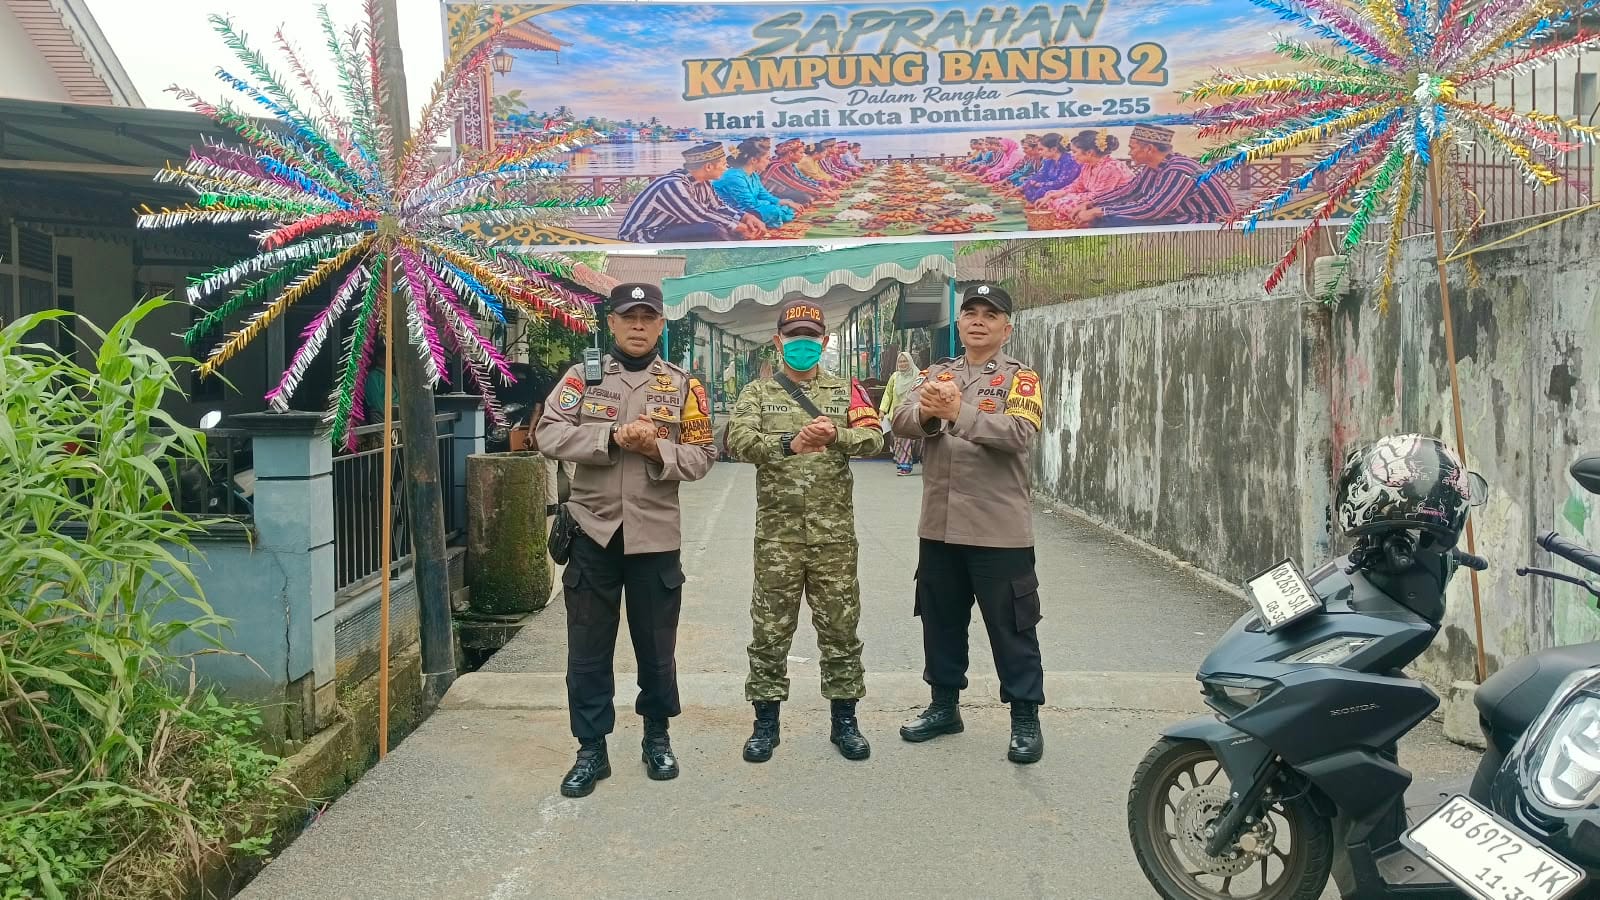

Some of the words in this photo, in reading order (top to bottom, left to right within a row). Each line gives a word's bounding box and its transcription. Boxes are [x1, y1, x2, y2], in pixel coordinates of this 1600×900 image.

[738, 0, 1105, 57] SAPRAHAN
[682, 52, 929, 101] KAMPUNG
[939, 45, 1125, 85] BANSIR
[1127, 41, 1169, 86] 2
[847, 89, 917, 106] Dalam
[923, 86, 1001, 105] Rangka
[704, 110, 765, 130] Hari
[772, 109, 830, 128] Jadi
[838, 108, 902, 127] Kota
[909, 101, 1050, 124] Pontianak
[1057, 97, 1152, 118] Ke-255
[785, 305, 821, 320] 1207-02
[646, 393, 681, 405] POLRI
[977, 388, 1007, 398] POLRI
[824, 406, 840, 415] TNI
[1271, 564, 1290, 580] KB
[1276, 575, 1301, 597] 2639
[1330, 703, 1380, 716] HONDA
[1439, 803, 1474, 829] KB
[1465, 822, 1522, 863] 6972
[1524, 861, 1569, 894] XK
